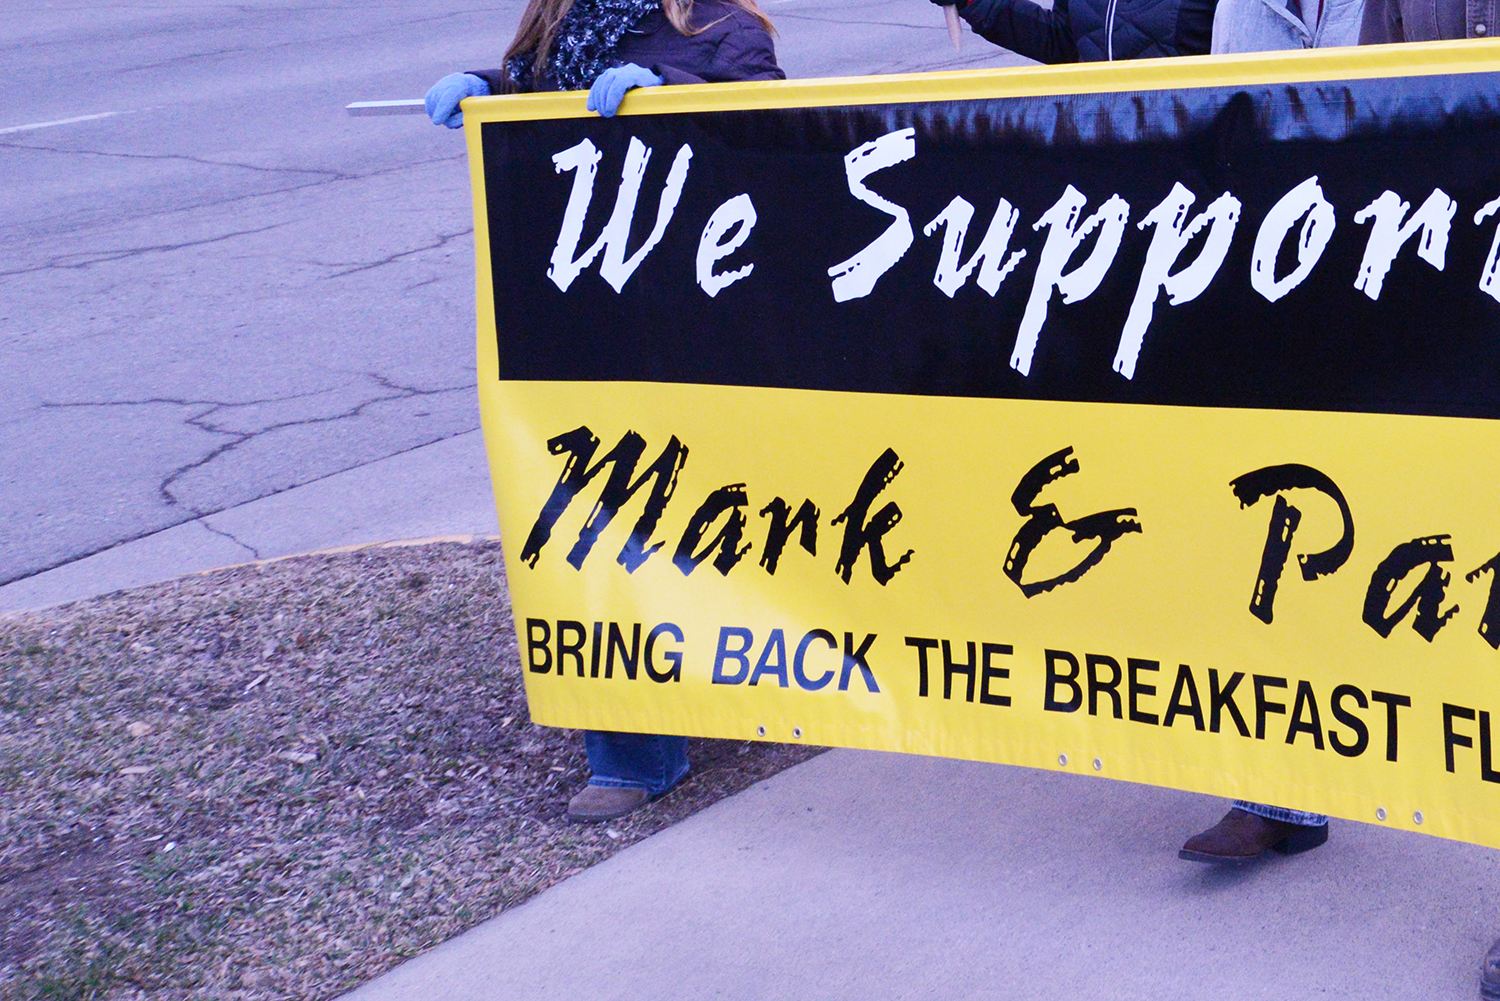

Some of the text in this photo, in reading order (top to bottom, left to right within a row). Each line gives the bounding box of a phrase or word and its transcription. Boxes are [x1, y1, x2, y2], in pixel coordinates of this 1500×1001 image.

[546, 135, 758, 298] We
[520, 424, 915, 587] Mark
[1003, 445, 1143, 600] &
[526, 617, 686, 684] BRING
[711, 625, 882, 693] BACK
[904, 636, 1014, 707] THE
[1043, 648, 1412, 763] BREAKFAST
